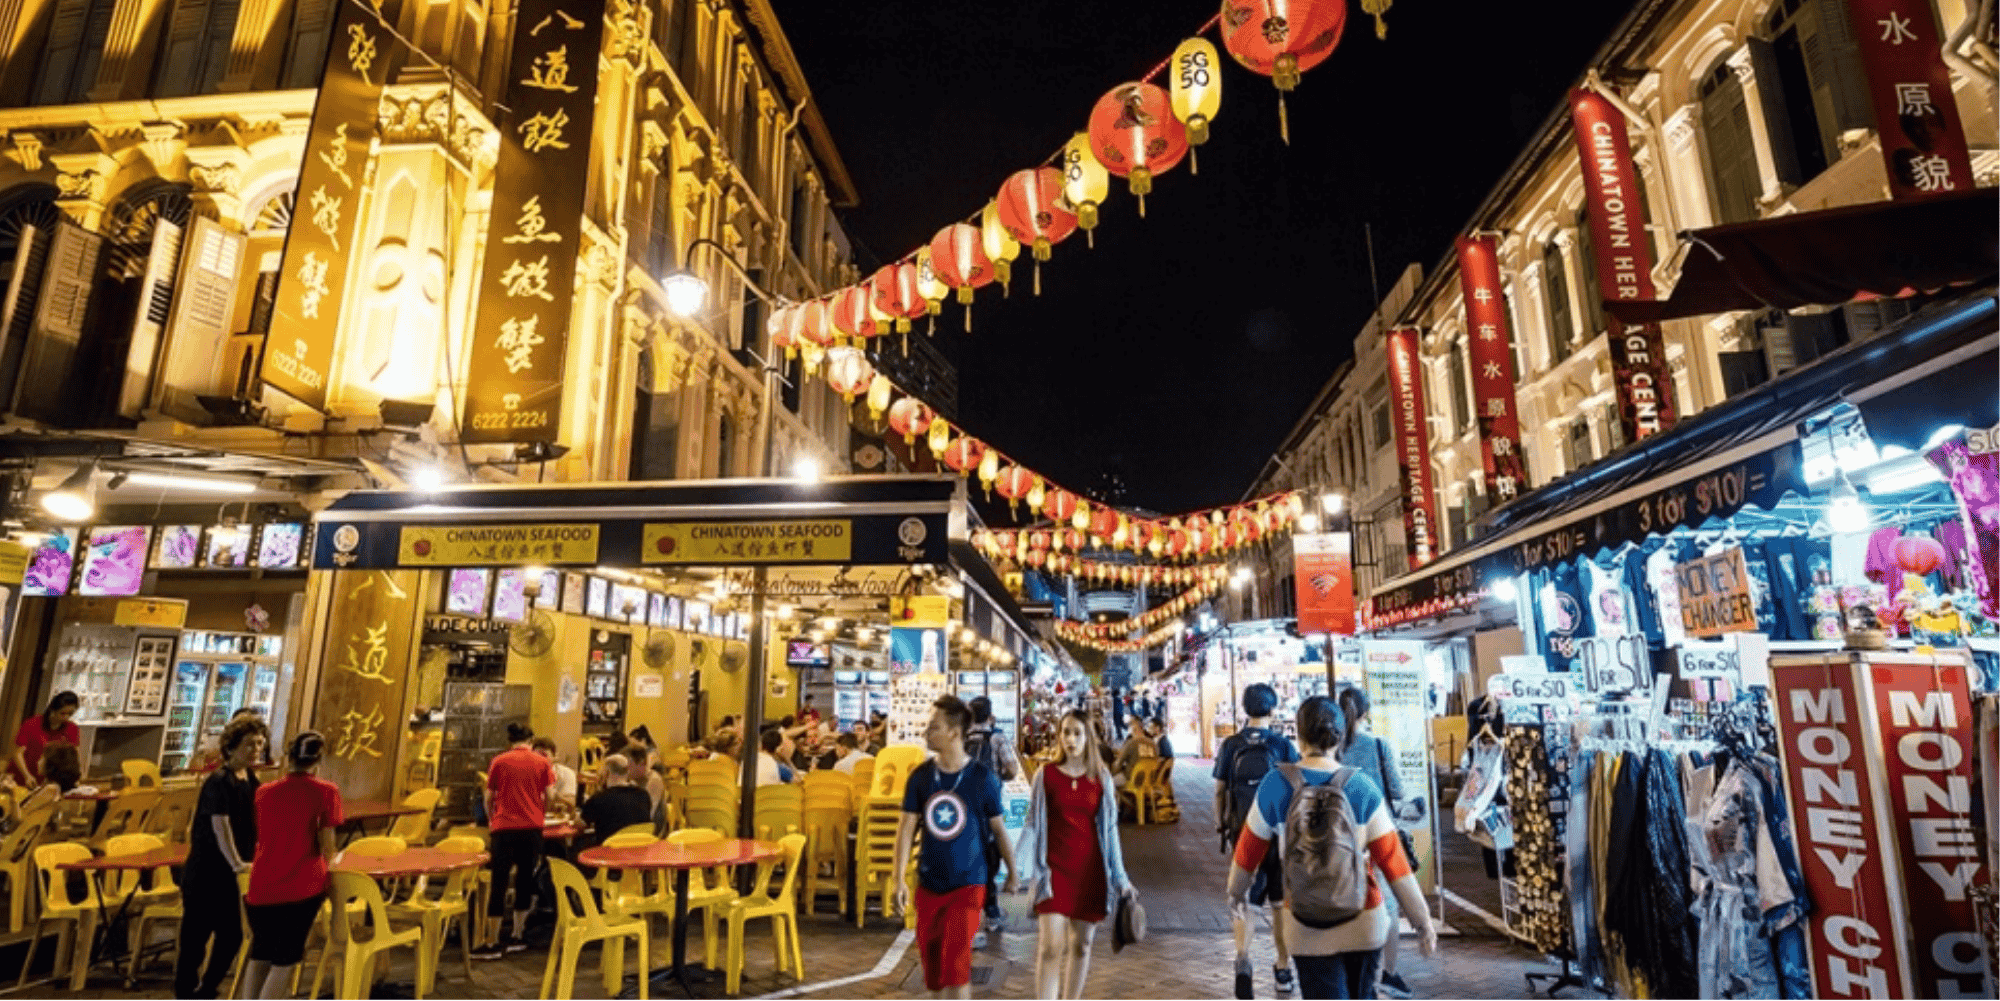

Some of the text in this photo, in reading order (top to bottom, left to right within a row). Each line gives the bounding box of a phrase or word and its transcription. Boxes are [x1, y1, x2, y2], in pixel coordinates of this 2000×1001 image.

[1179, 51, 1209, 69] SG
[1180, 69, 1210, 89] 50
[1877, 11, 1955, 191] 水原貌
[1592, 121, 1631, 250] CHINATOWN
[1613, 256, 1650, 365] HERAGE
[1396, 350, 1417, 433] CHINATOWN
[471, 411, 548, 430] 6222 2224
[1405, 436, 1425, 503] HERITAGE
[690, 524, 843, 538] CHINATOWN SEAFOOD
[1638, 500, 1652, 533] 3
[1656, 493, 1688, 526] for
[446, 529, 592, 543] CHINATOWN SEAFOOD
[1522, 542, 1544, 567] for
[1675, 551, 1740, 597] MONEY
[1681, 592, 1756, 631] CHANGER
[1683, 652, 1696, 672] 6
[1512, 678, 1524, 698] 6
[1789, 688, 1868, 889] MONEY
[1888, 690, 1981, 901] MONEY
